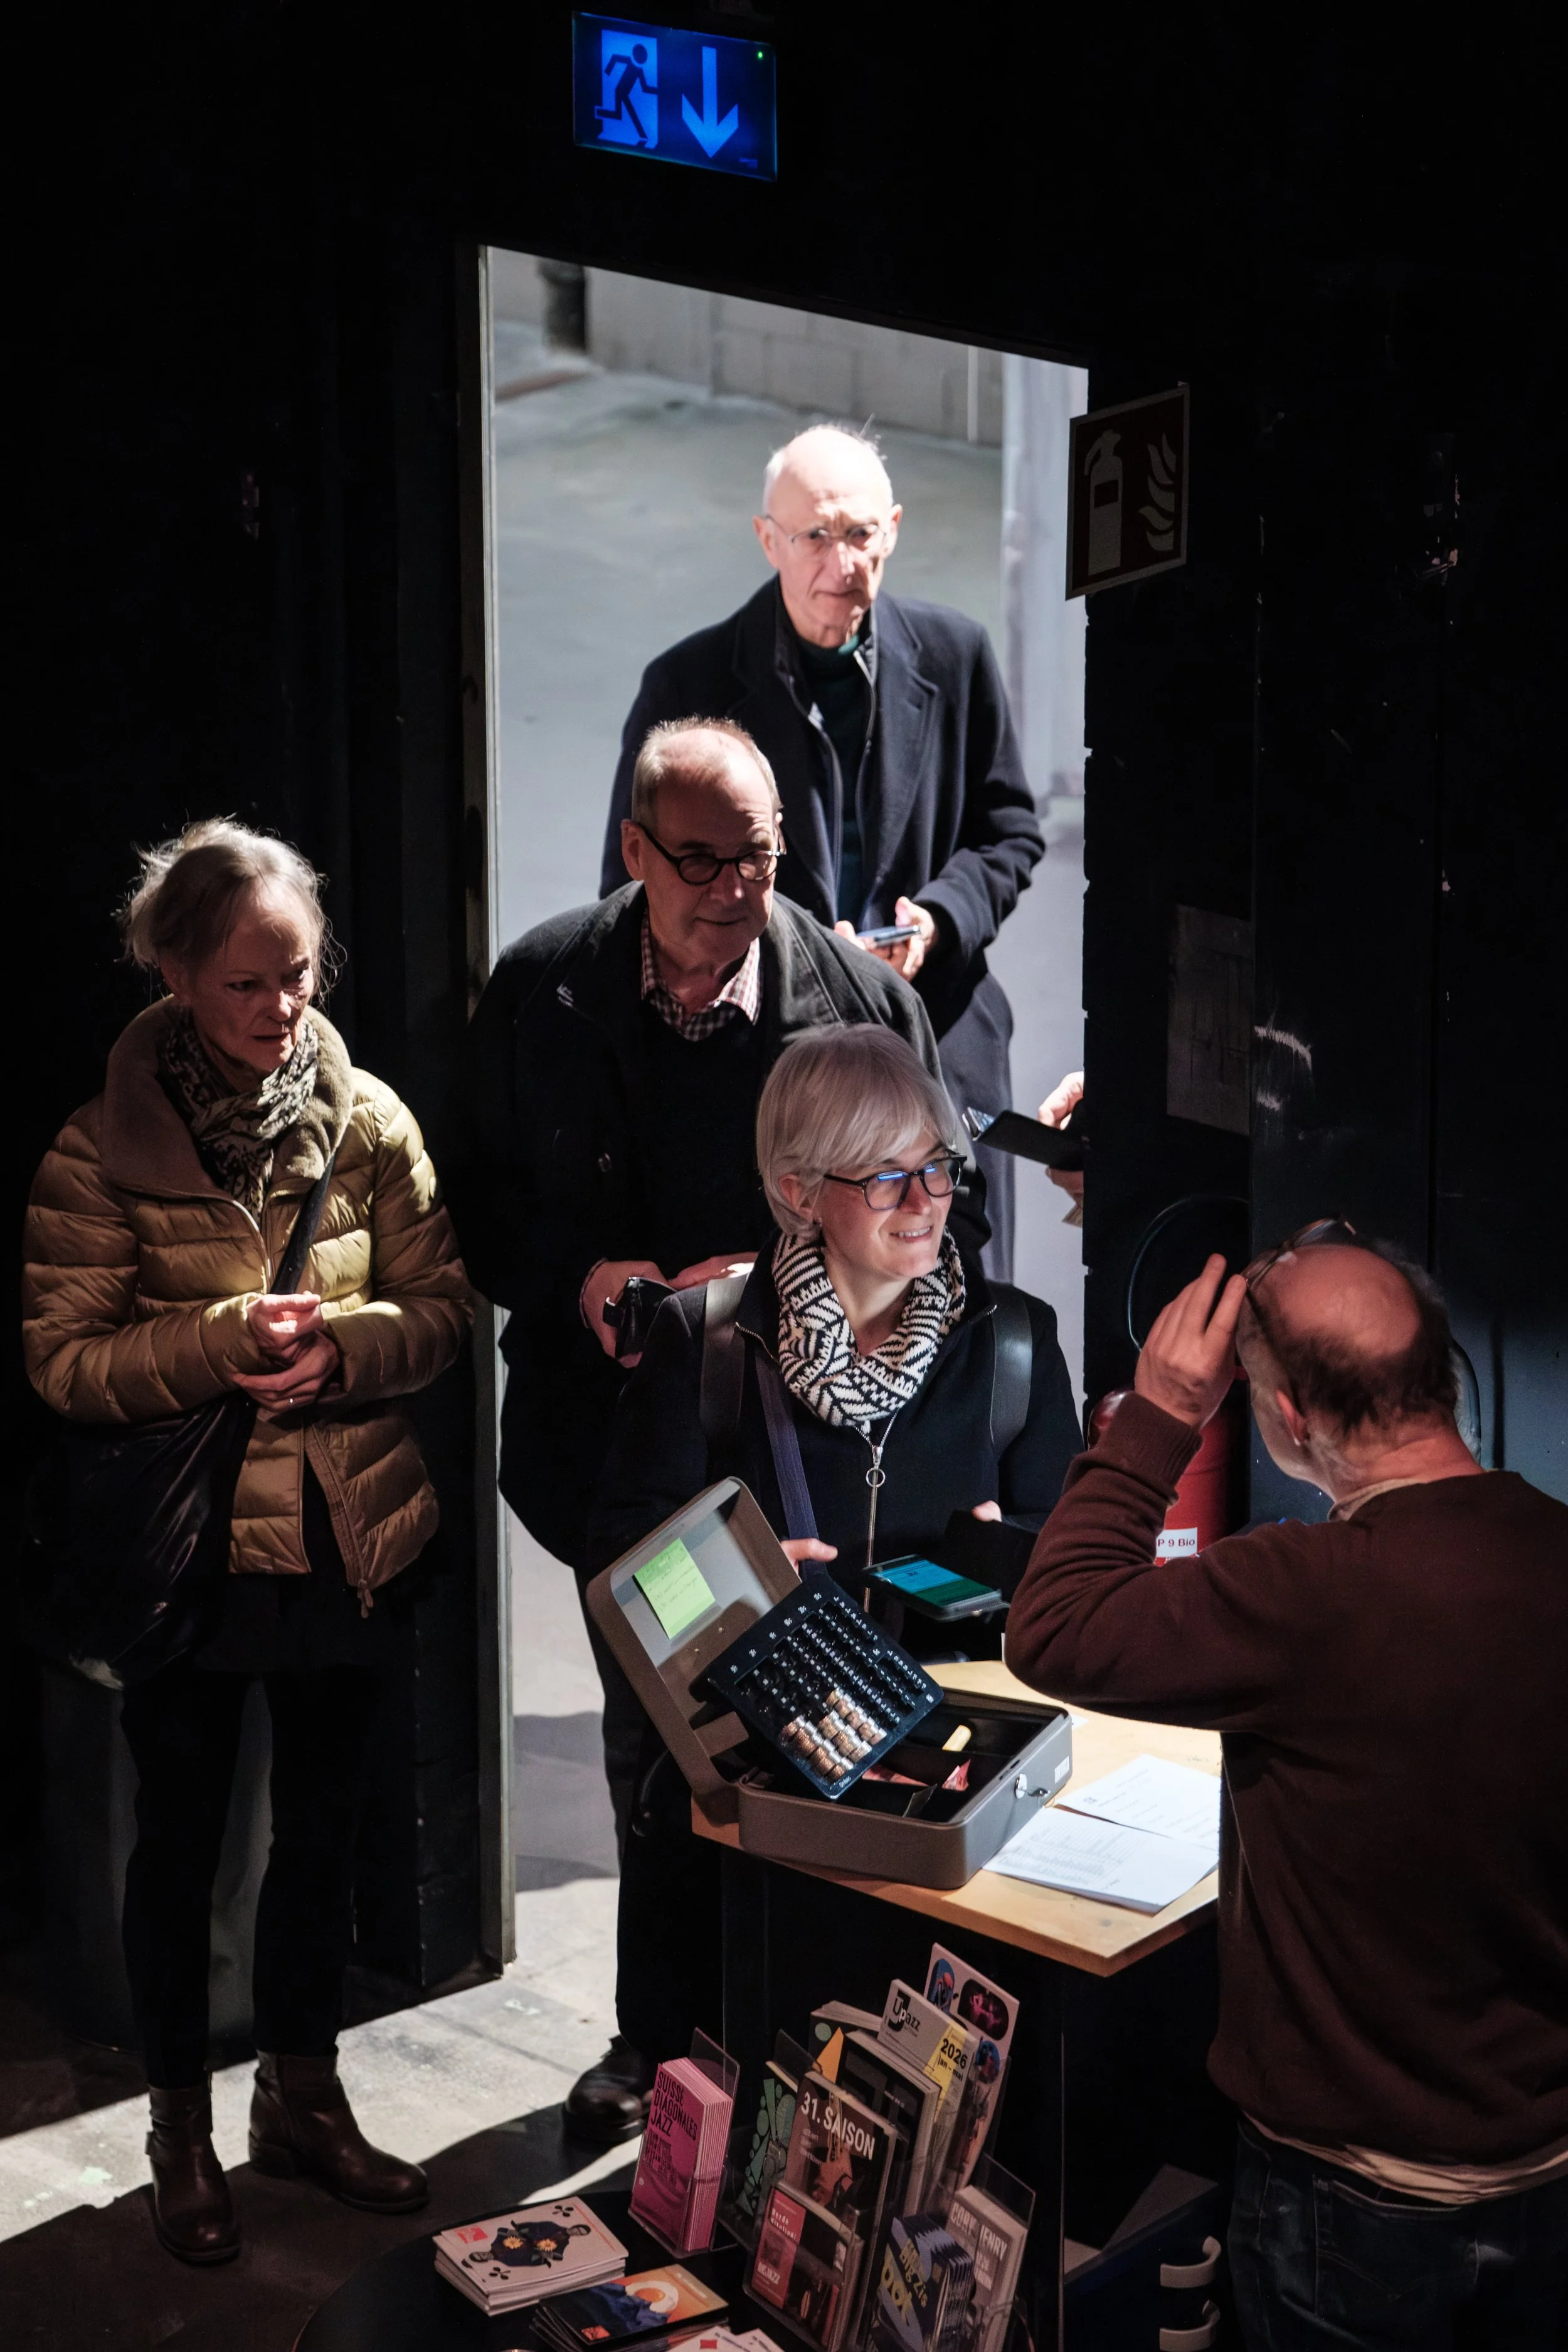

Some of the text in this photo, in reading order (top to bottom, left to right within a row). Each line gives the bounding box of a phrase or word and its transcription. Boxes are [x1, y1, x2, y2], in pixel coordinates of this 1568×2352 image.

[1168, 1539, 1175, 1547] 9
[1178, 1538, 1195, 1547] Bio
[941, 2038, 968, 2069] 2026
[658, 2071, 685, 2106] SUISSE
[651, 2109, 673, 2137] JAZZ
[654, 2088, 697, 2141] DIAGONALES
[801, 2092, 820, 2124] 31.
[824, 2106, 876, 2161] SAISON
